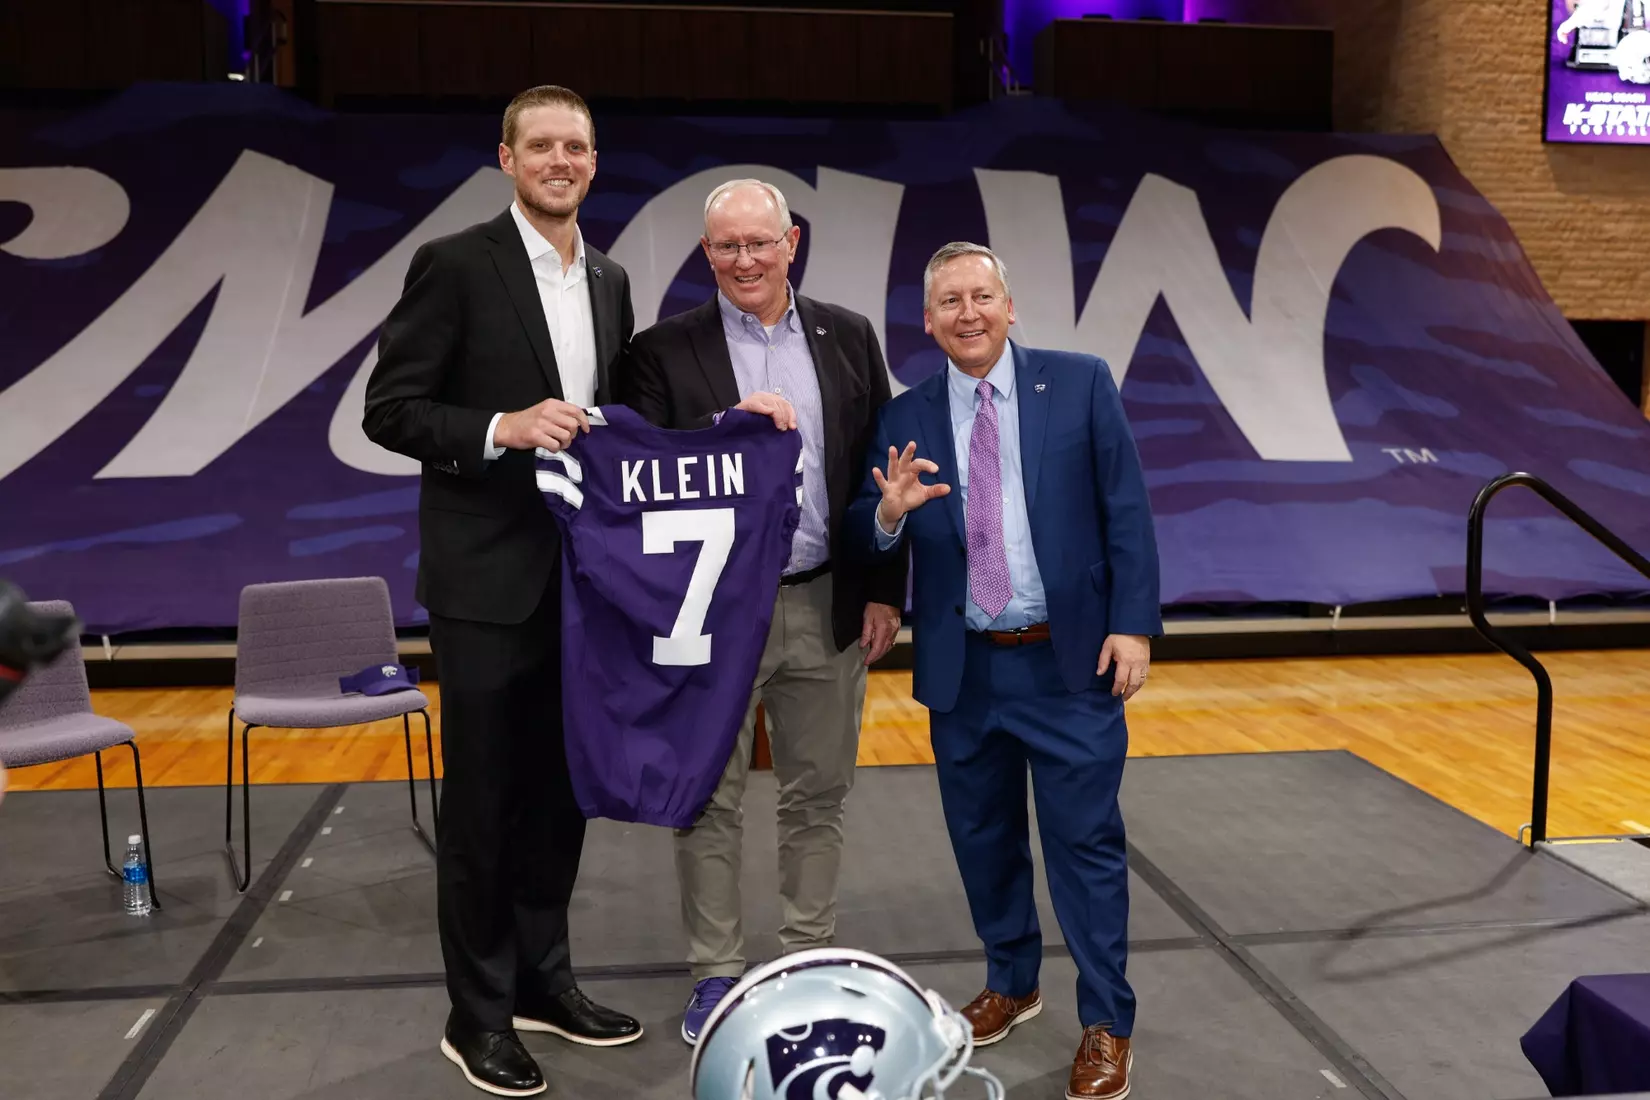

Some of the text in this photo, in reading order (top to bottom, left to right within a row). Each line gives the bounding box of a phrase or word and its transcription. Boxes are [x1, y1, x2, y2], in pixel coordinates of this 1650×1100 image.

[1562, 103, 1650, 126] K-STAT
[1569, 124, 1648, 136] FOOTBAL
[1381, 447, 1439, 463] TM
[621, 452, 745, 503] KLEIN
[641, 507, 735, 666] 7
